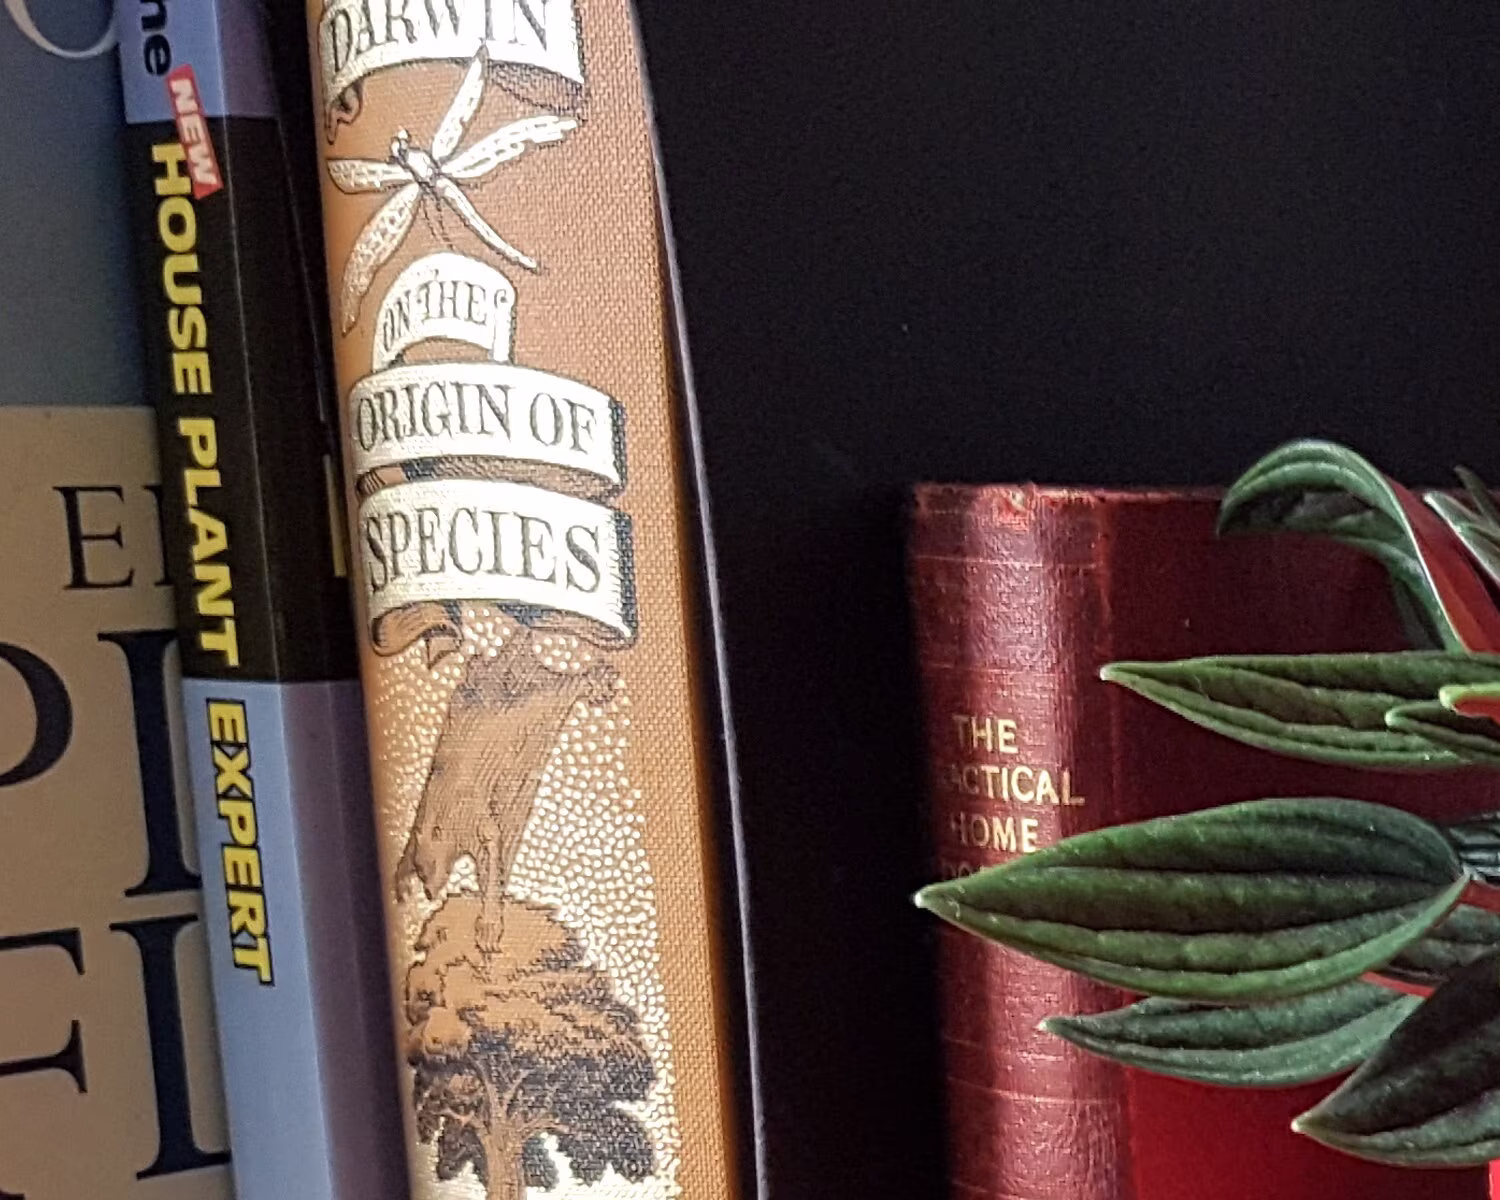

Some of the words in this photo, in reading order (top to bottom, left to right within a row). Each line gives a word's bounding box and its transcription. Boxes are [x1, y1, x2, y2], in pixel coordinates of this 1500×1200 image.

[331, 0, 549, 74] DARWIN
[168, 77, 219, 187] NEW
[151, 142, 213, 395] HOUSE
[357, 381, 512, 452] ORIGIN
[530, 392, 597, 455] OF
[178, 418, 240, 668] PLANT
[366, 506, 602, 594] SPECIES
[952, 714, 1019, 755] THE
[206, 697, 275, 987] EXPERT
[950, 810, 1039, 854] HOME
